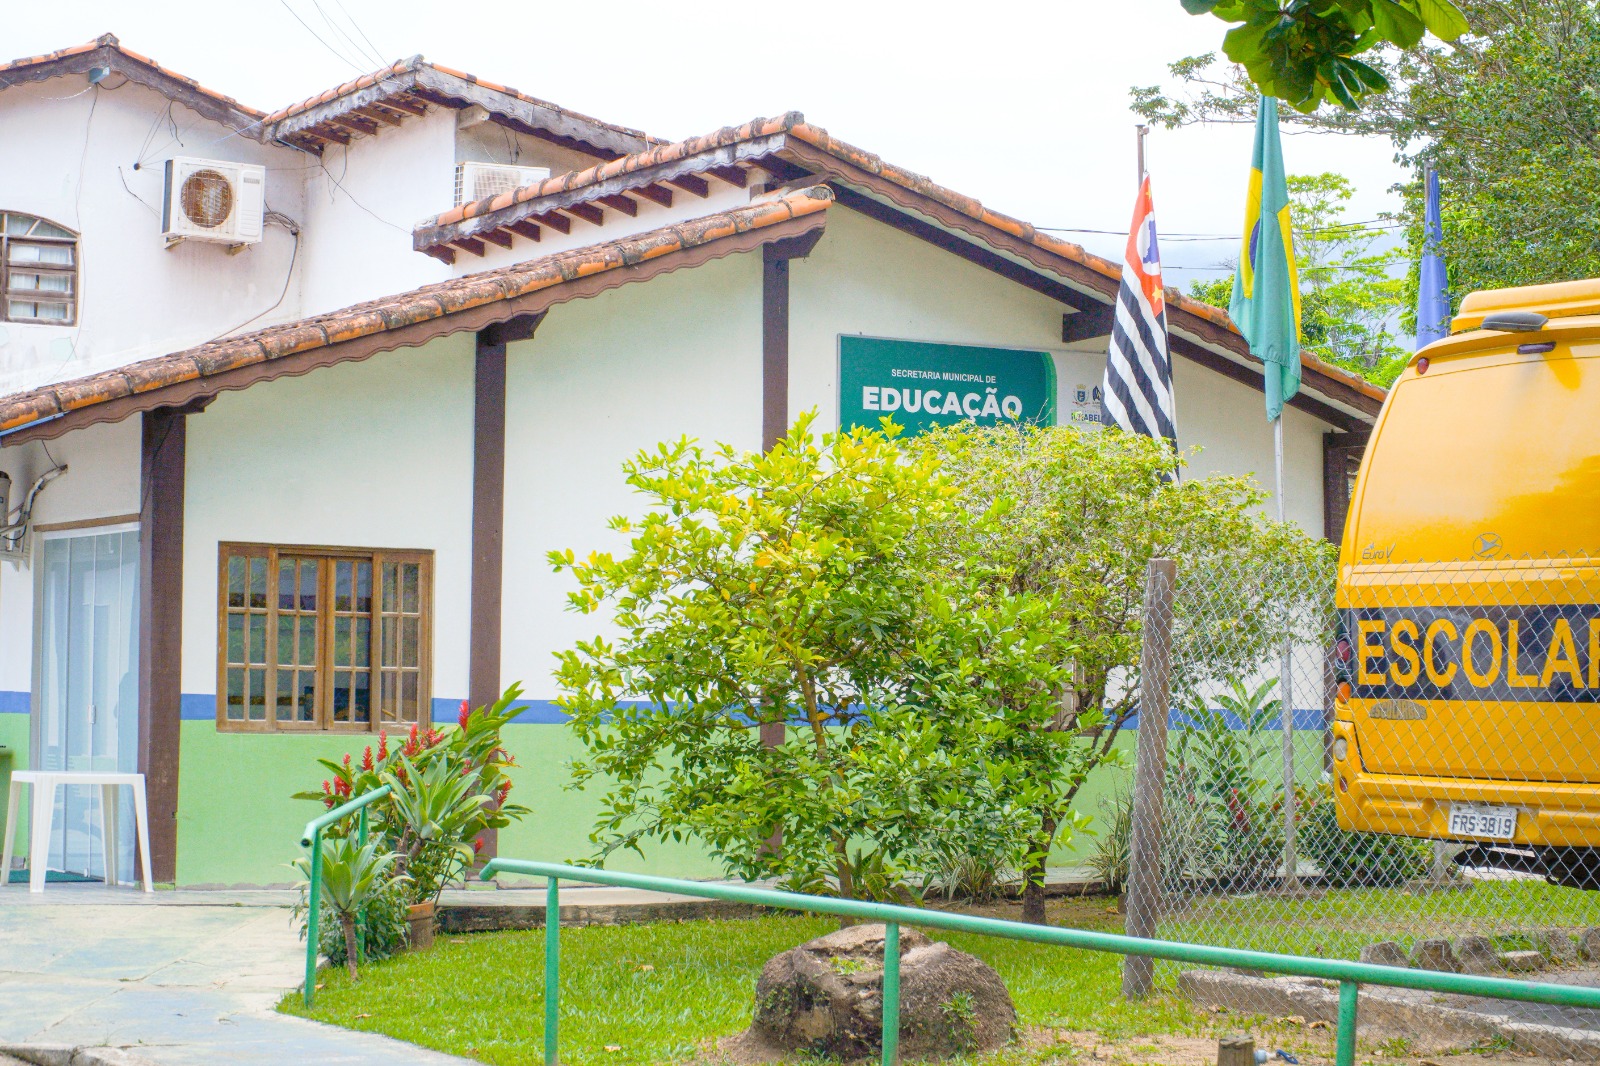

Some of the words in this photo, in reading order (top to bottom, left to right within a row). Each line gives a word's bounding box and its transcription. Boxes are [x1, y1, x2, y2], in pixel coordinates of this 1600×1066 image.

[891, 369, 940, 380] SECRETARIA
[942, 372, 984, 383] MUNICIPAL
[985, 375, 996, 384] DE
[863, 386, 1022, 423] EDUCAÇÃO
